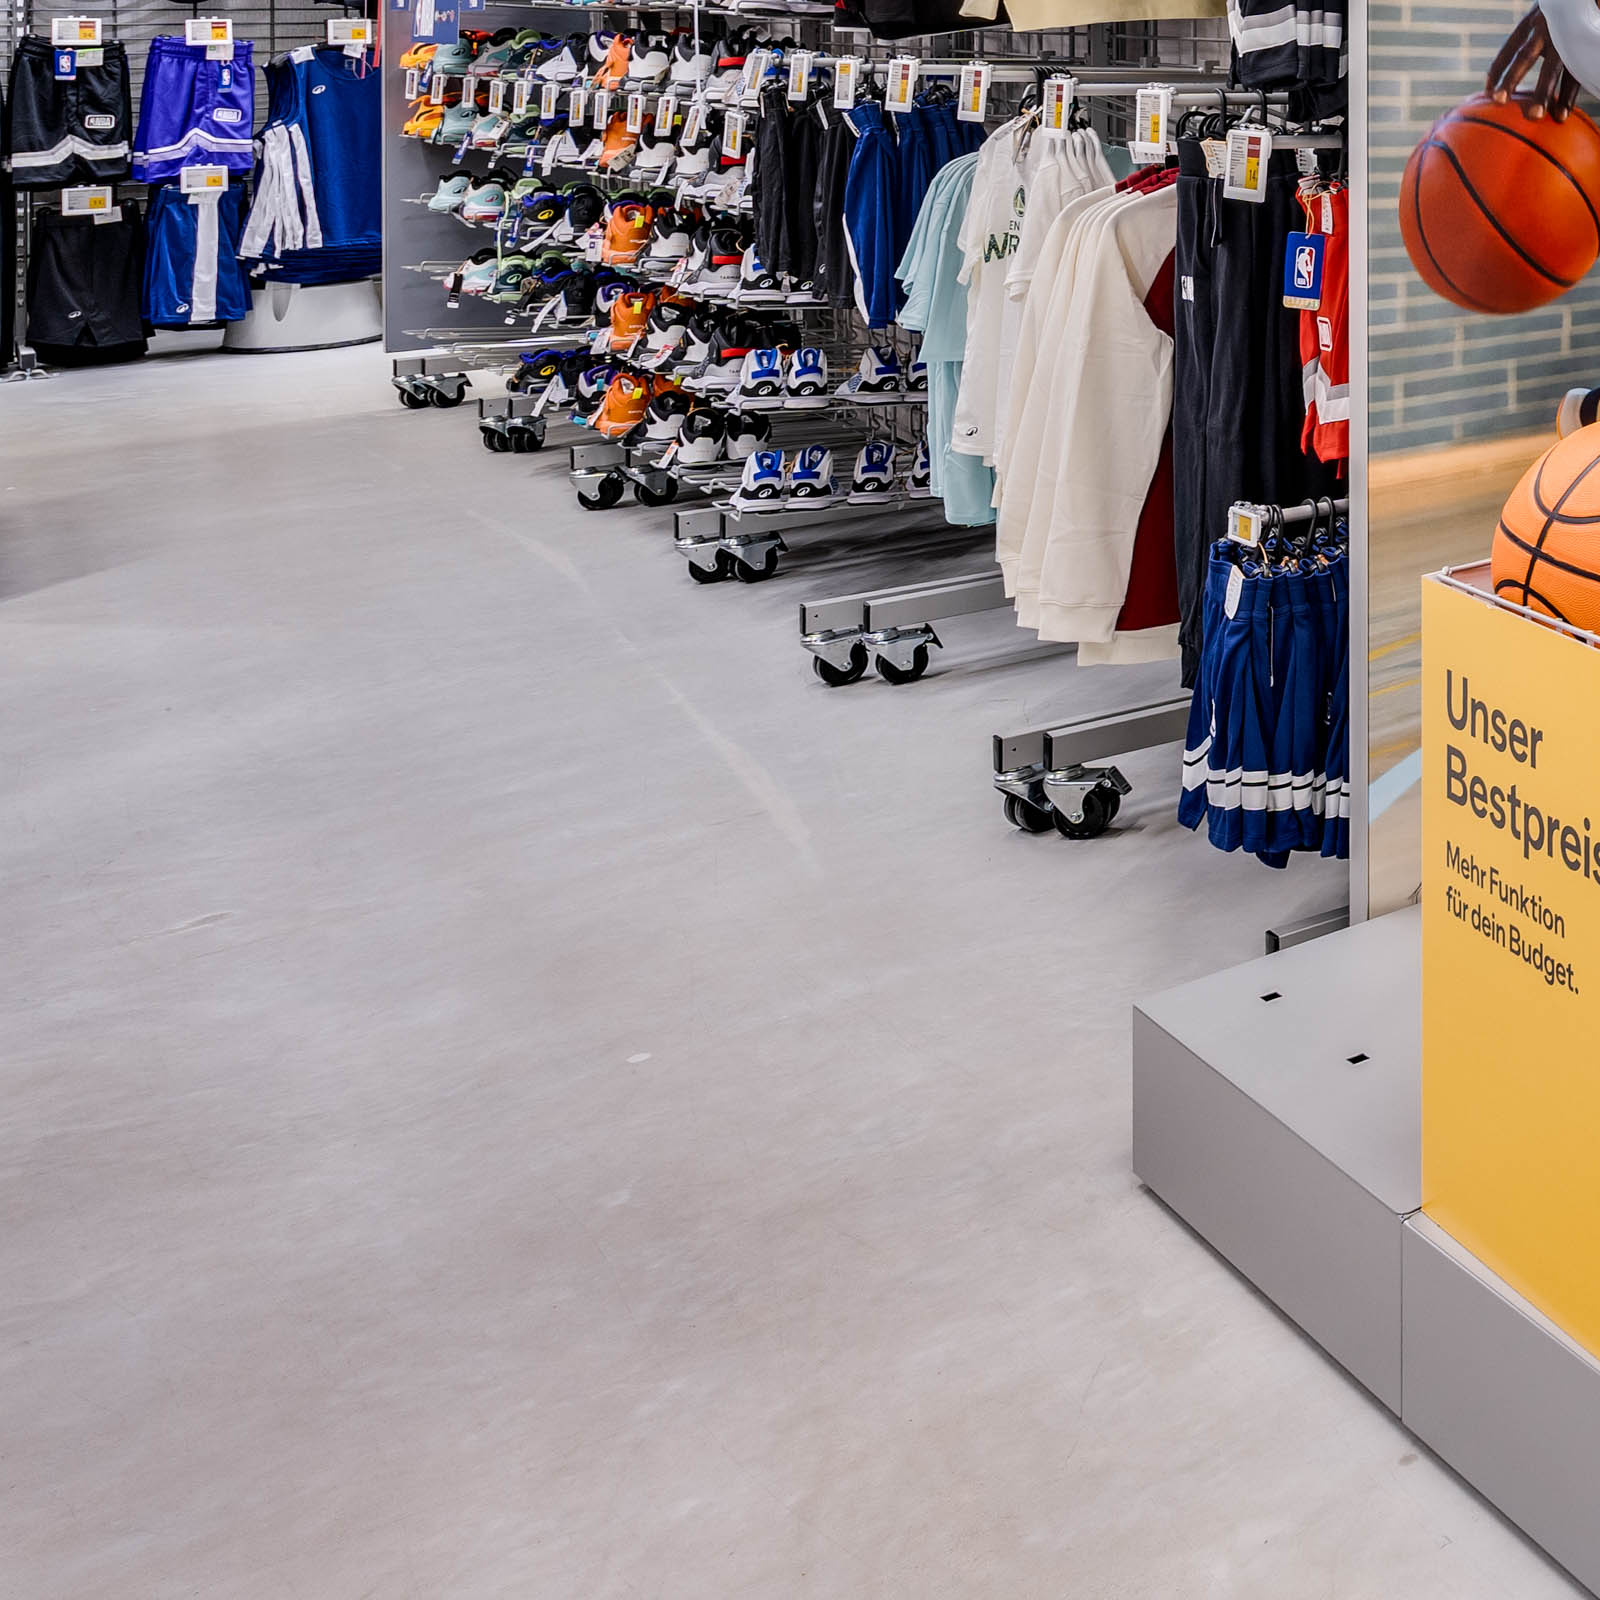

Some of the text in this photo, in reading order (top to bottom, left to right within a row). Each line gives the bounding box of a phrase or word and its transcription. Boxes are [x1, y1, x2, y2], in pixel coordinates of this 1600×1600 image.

[1447, 668, 1543, 769] Unser
[1446, 839, 1566, 939] Mehr Funktion
[1446, 884, 1580, 996] für dein Budget.
